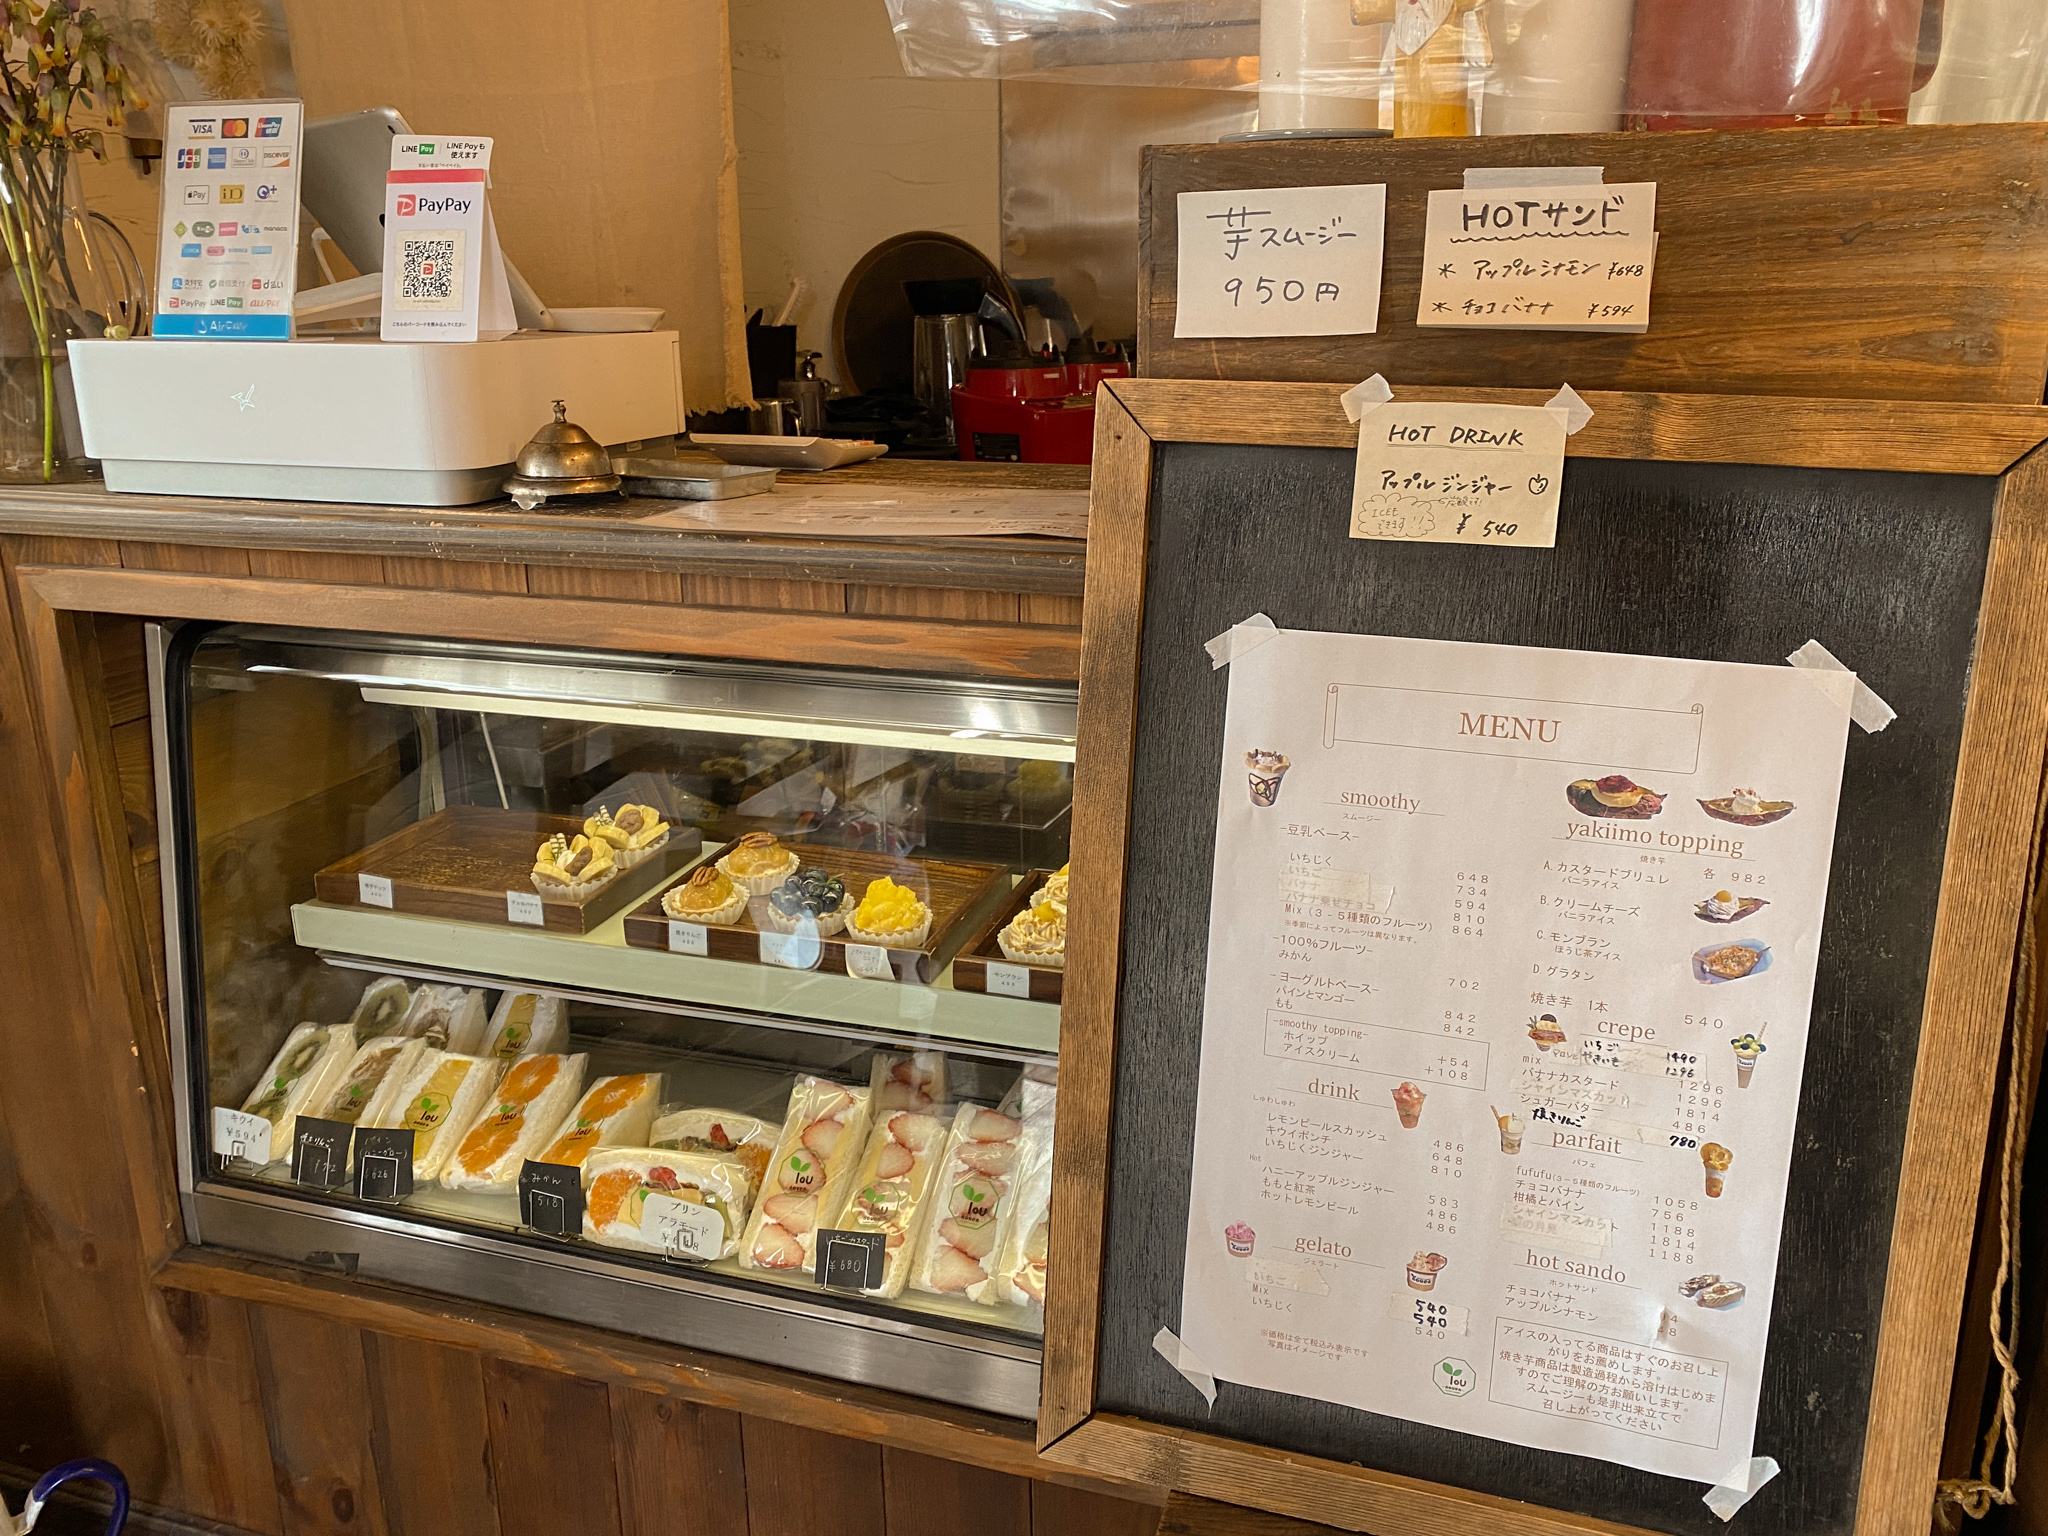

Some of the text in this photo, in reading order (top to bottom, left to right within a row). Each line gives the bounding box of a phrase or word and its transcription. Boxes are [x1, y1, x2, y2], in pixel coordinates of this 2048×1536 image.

[192, 125, 212, 134] VISA
[178, 154, 200, 162] JCB
[193, 191, 206, 200] Pay
[223, 188, 242, 200] iD
[418, 198, 472, 214] PayPay
[1206, 205, 1358, 260] 芋スムージー
[1475, 259, 1644, 281] アップルシナモン ¥648
[1224, 277, 1340, 307] 950円
[180, 300, 206, 308] PayPay
[228, 298, 242, 307] Pay
[1462, 298, 1635, 318] チョコバナナ ¥594
[1388, 424, 1524, 446] HOT DRINK
[1381, 470, 1512, 495] アップルジンジャー
[1483, 520, 1518, 538] 540
[1457, 711, 1562, 742] MENU
[1341, 790, 1421, 814] smoothy
[1342, 812, 1381, 822] スムージー
[1566, 820, 1745, 858] yakiimo topping
[1290, 852, 1332, 866] いちじく
[1640, 854, 1666, 865] 焼き芋
[1456, 872, 1488, 884] 648
[1558, 862, 1670, 884] カスタードブリュレ
[1704, 868, 1766, 884] 各 982
[1562, 876, 1620, 890] バニラアイス
[1456, 886, 1487, 897] 734
[1284, 904, 1302, 915] Mix
[1454, 899, 1486, 911] 594
[1554, 898, 1640, 917] クリームチーズ
[1453, 912, 1484, 925] 810
[1558, 911, 1615, 924] バニラアイス
[1452, 925, 1484, 938] 864
[1550, 932, 1611, 948] モンブラン
[1278, 950, 1312, 962] みかん
[1554, 944, 1621, 962] ほうじ茶アイス
[1546, 965, 1595, 982] グラタン
[1448, 978, 1480, 990] 702
[1276, 998, 1292, 1010] もも
[1530, 991, 1608, 1013] 焼き芋 1本
[1444, 1010, 1476, 1023] 842
[1684, 1014, 1724, 1029] 540
[1444, 1023, 1474, 1036] 842
[1598, 1020, 1656, 1043] crepe
[1284, 1032, 1328, 1046] ホイップ
[1284, 1043, 1360, 1064] アイスクリーム
[1522, 1054, 1541, 1064] mix
[1666, 1052, 1696, 1064] 1490
[1438, 1055, 1469, 1068] +54
[1424, 1066, 1468, 1081] +108
[1522, 1068, 1620, 1090] バナナカスタード
[1308, 1078, 1360, 1101] drink
[1678, 1080, 1724, 1095] 1296
[1253, 1094, 1296, 1107] しゅわしゅわ
[1520, 1094, 1604, 1113] シュガーバター
[1677, 1094, 1722, 1108] 1296
[230, 1114, 254, 1126] キウイ
[1674, 1107, 1720, 1122] 1814
[1672, 1120, 1706, 1134] 486
[226, 1128, 256, 1142] ¥594
[1552, 1130, 1622, 1155] parfait
[1669, 1135, 1696, 1149] 780
[1266, 1138, 1364, 1161] いちじくジンジャー
[1433, 1140, 1465, 1152] 486
[1250, 1154, 1262, 1162] Hot
[1432, 1153, 1463, 1166] 648
[1430, 1165, 1462, 1178] 810
[532, 1174, 562, 1185] みかん
[1262, 1166, 1395, 1194] ハニーアップルジンジャー
[1263, 1176, 1316, 1195] ももと紅茶
[1516, 1179, 1586, 1199] チョコバナナ
[670, 1202, 701, 1216] プリン
[1428, 1195, 1459, 1209] 583
[1653, 1196, 1698, 1210] 1058
[1427, 1208, 1458, 1222] 486
[1652, 1208, 1684, 1222] 756
[658, 1216, 708, 1236] アラモード
[1426, 1222, 1456, 1235] 486
[1651, 1222, 1695, 1238] 1188
[1295, 1235, 1352, 1258] gelato
[1650, 1235, 1695, 1251] 1814
[1304, 1258, 1339, 1269] ジェラート
[1650, 1248, 1694, 1264] 1188
[829, 1260, 862, 1272] ¥680
[1526, 1248, 1626, 1283] hot sando
[1252, 1284, 1269, 1295] Mix
[1550, 1279, 1598, 1294] ホットサンド
[1506, 1285, 1576, 1304] チョコバナナ
[1252, 1296, 1292, 1312] いちじく
[1416, 1298, 1448, 1316] 540
[1504, 1296, 1598, 1322] アップルシナモン
[1413, 1312, 1448, 1328] 540
[1414, 1327, 1445, 1340] 540
[1260, 1329, 1369, 1358] ※価格は全て税込み表示です
[1268, 1339, 1342, 1362] 写真はイメージです
[1502, 1325, 1719, 1377] アイスの入ってる商品はすぐのお召し上
[1548, 1347, 1662, 1380] がりをお薦めします。
[1500, 1350, 1716, 1404] 焼き芋商品は製造過程から溶けはじめま
[1516, 1366, 1688, 1413] すのでご理解の方お願いします。
[1526, 1382, 1682, 1424] スムージーも是非出来立てで
[1543, 1398, 1662, 1432] 召し上がってください
